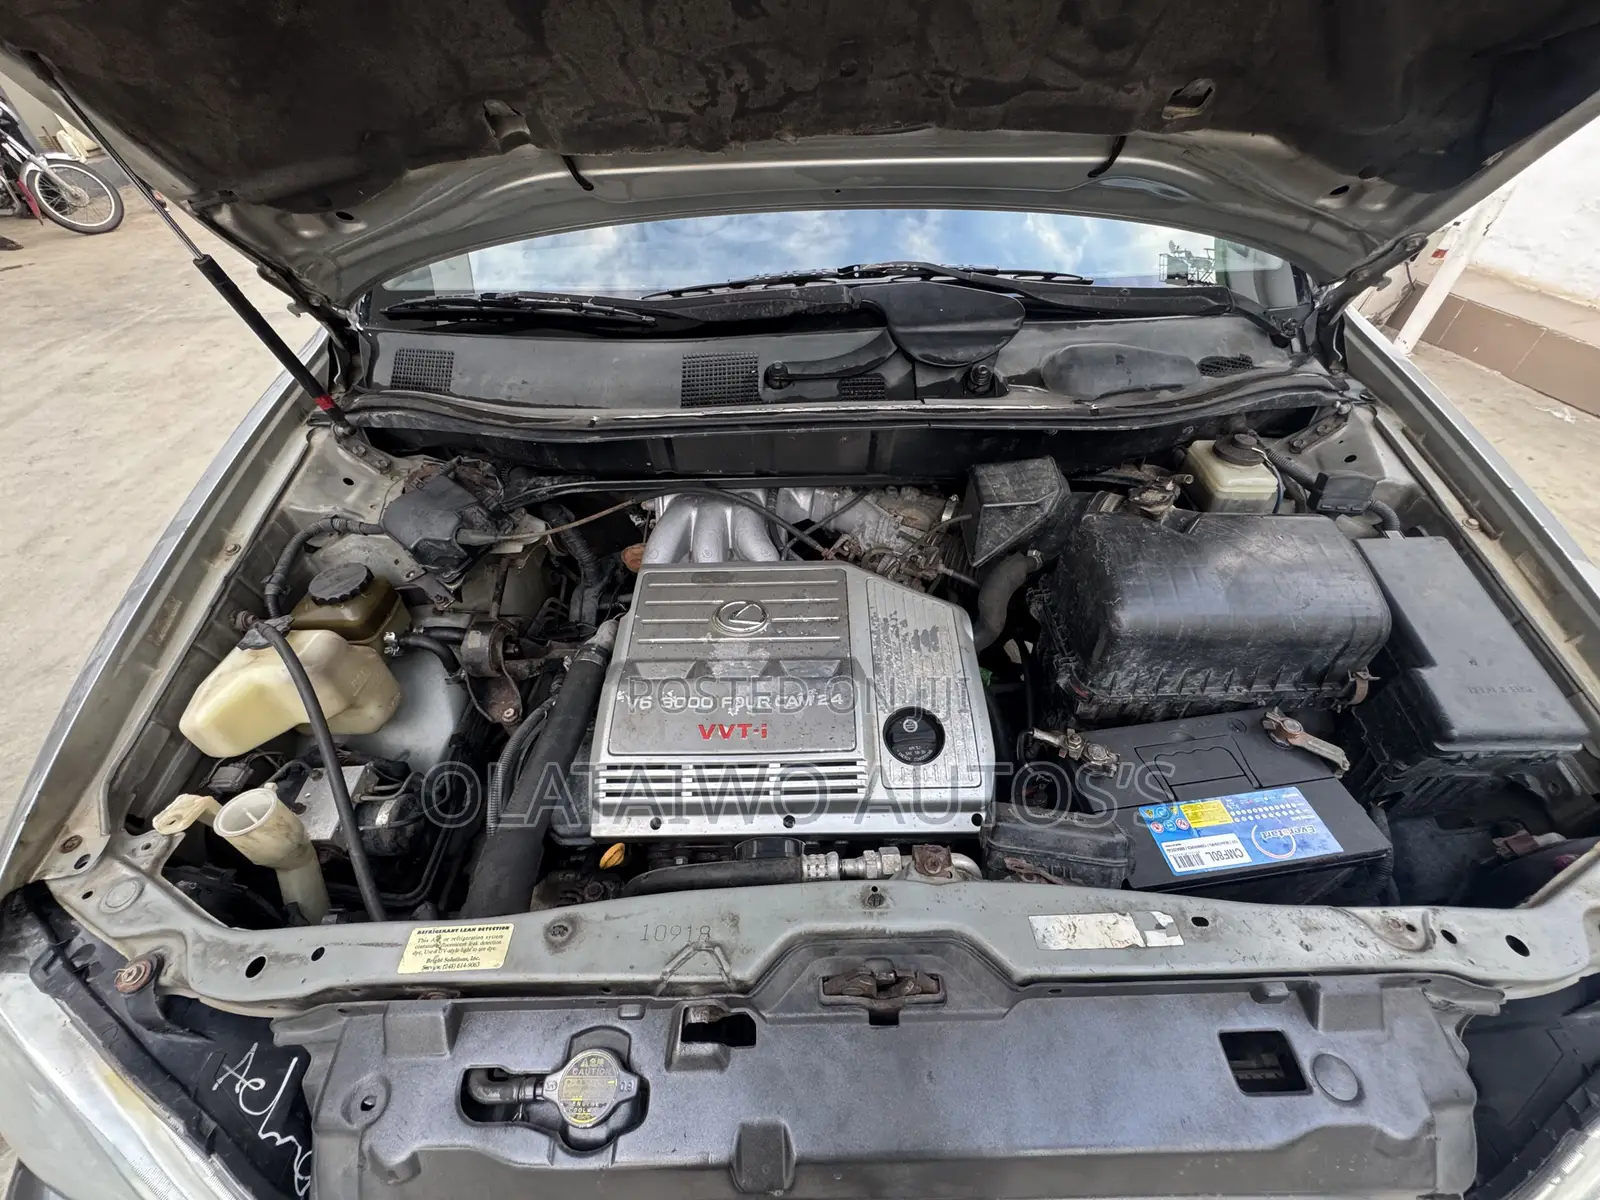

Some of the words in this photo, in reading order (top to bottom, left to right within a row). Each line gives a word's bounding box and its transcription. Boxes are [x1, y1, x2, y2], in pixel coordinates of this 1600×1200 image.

[627, 695, 652, 710] V6
[817, 693, 844, 706] 24
[698, 723, 768, 740] VVT-i
[1205, 847, 1244, 862] CMF80L
[571, 1066, 613, 1076] CAUTION
